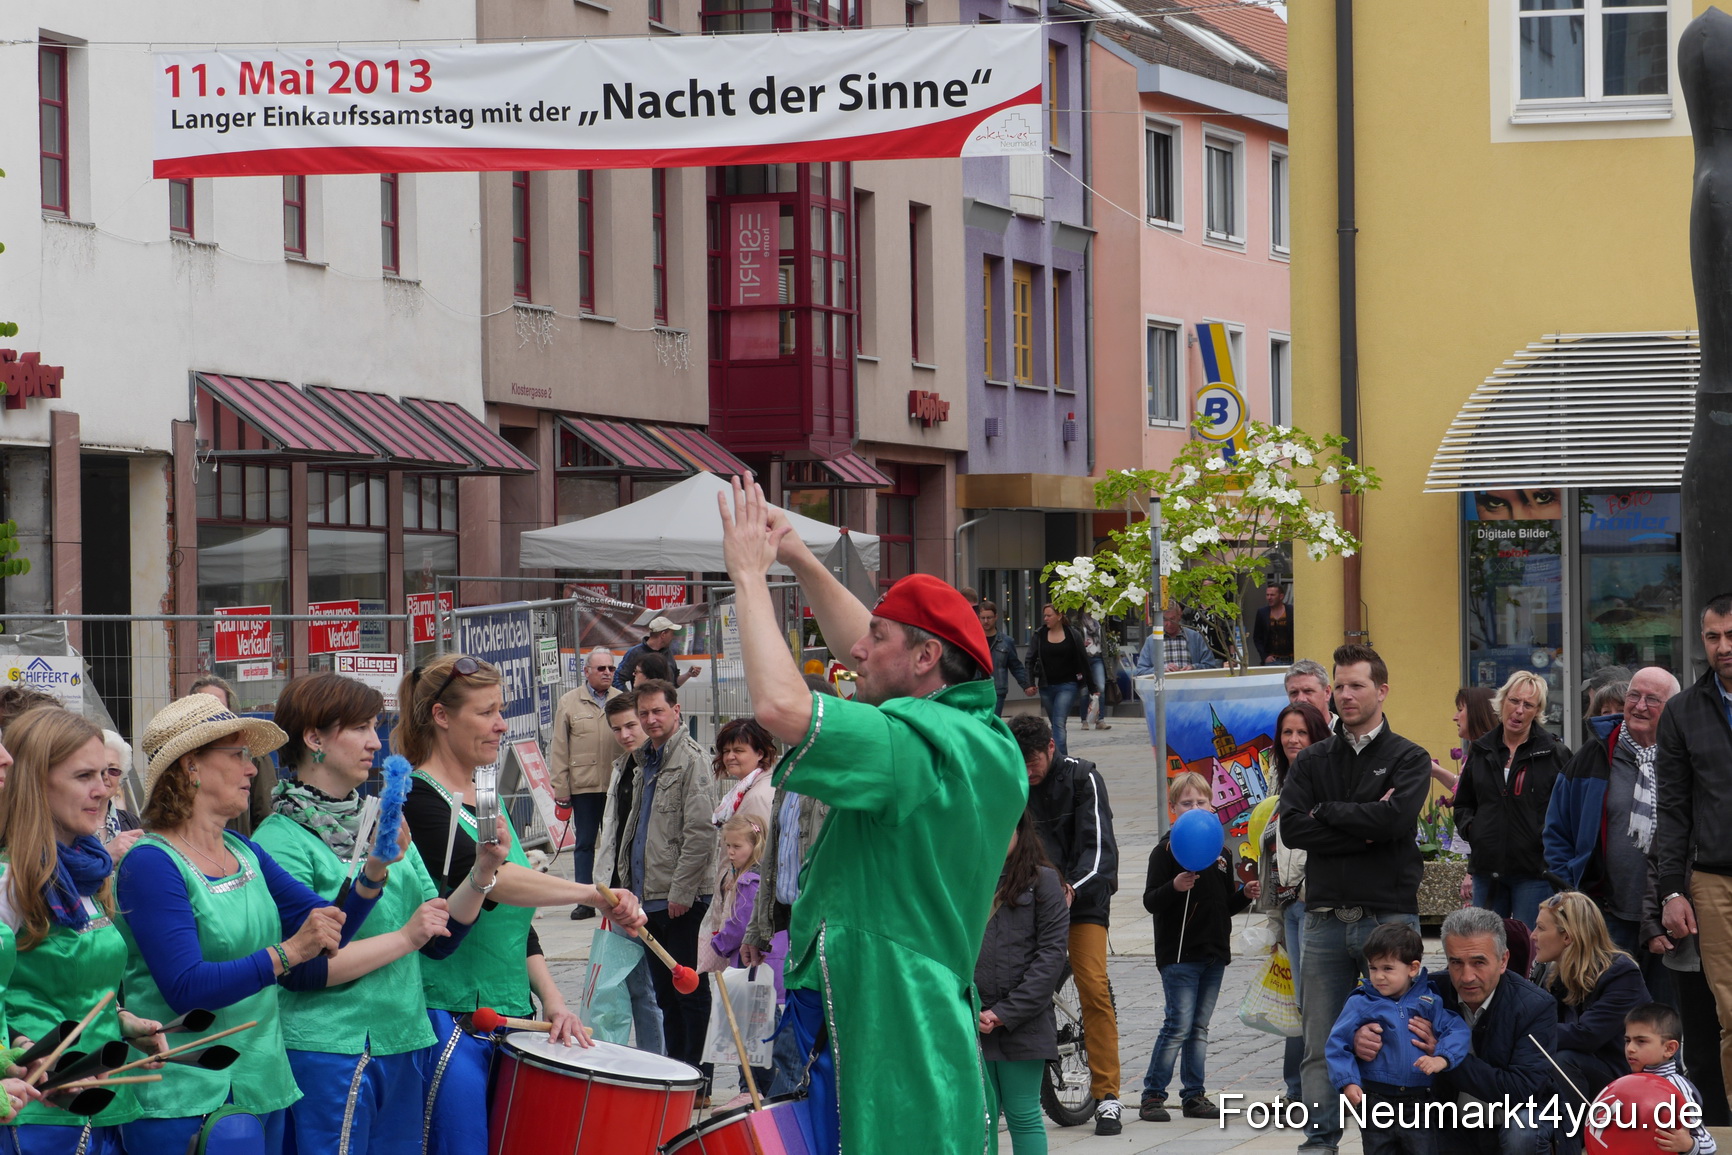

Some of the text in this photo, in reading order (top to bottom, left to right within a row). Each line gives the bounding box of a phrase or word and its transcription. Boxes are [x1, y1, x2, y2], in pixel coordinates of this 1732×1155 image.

[165, 58, 433, 98] 11. Mai 2013
[171, 109, 257, 133] Langer
[263, 104, 474, 129] Einkaufssamstag
[481, 101, 523, 123] mit
[529, 100, 571, 122] der
[748, 75, 826, 115] der
[1000, 140, 1037, 148] Neumarkt
[0, 348, 64, 410] öpfer
[511, 382, 553, 400] Klostergasse 2
[1203, 397, 1229, 425] B
[1605, 490, 1653, 515] FOTO
[1477, 528, 1550, 541] Digitale Bilder
[236, 631, 272, 656] Verkauf
[327, 624, 360, 648] Verkauf
[462, 612, 530, 655] Trockenbau
[11, 670, 70, 683] SCHIFFERT
[357, 657, 396, 672] Rieger
